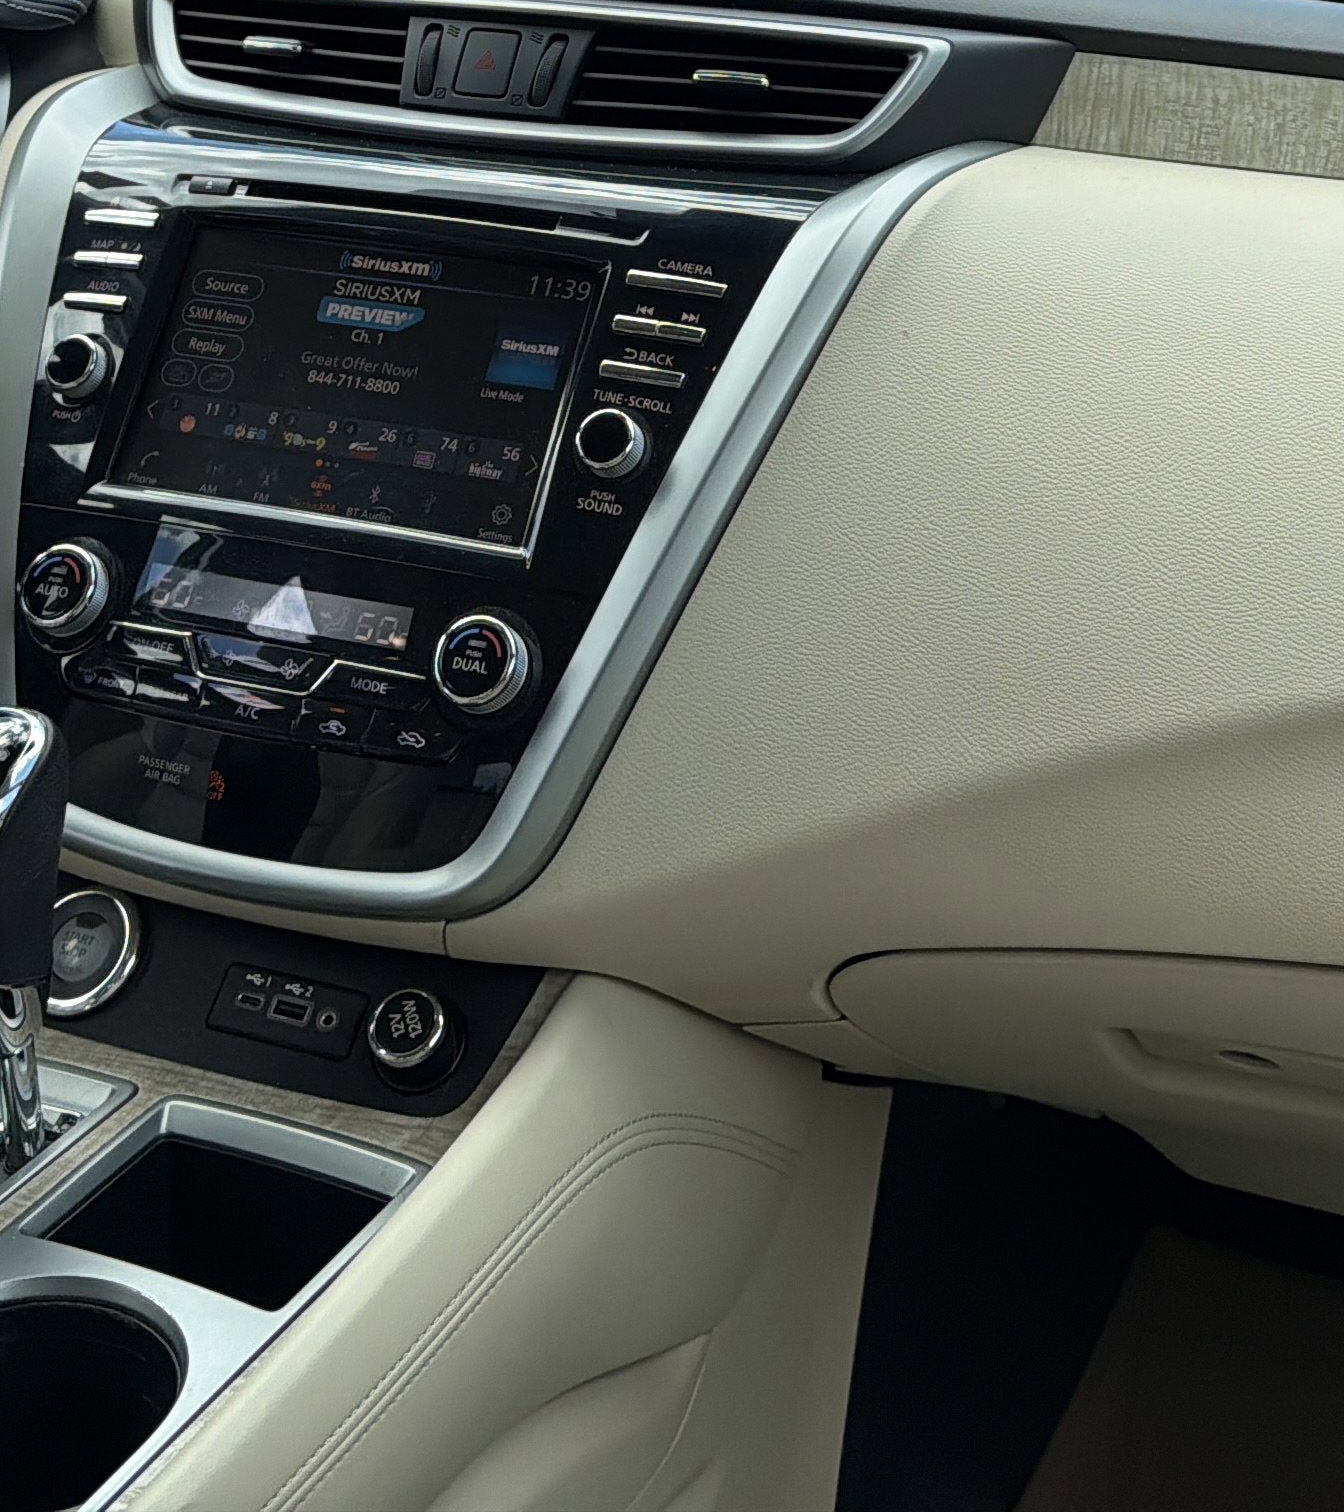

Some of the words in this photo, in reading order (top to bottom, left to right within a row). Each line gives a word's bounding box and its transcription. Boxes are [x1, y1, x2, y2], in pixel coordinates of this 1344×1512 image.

[90, 239, 114, 250] MAP
[657, 258, 713, 276] CAMERA
[87, 279, 120, 292] AUDIO
[204, 276, 249, 295] Source
[333, 279, 422, 305] SIRIUSXM
[527, 275, 592, 301] 11:39
[187, 305, 214, 321] SXM
[214, 308, 248, 325] Menu
[325, 302, 414, 326] PREVIEW
[351, 328, 372, 345] Ch.
[187, 336, 226, 356] Replay
[500, 338, 560, 357] SiriusXM
[300, 350, 338, 369] Great
[342, 356, 378, 375] Offer
[381, 361, 419, 379] Now!
[638, 350, 675, 367] BACK
[307, 369, 400, 395] 844-711-8800
[480, 387, 498, 400] Live
[498, 390, 525, 403] Mode
[205, 402, 221, 416] 11
[267, 411, 279, 425] 8
[327, 419, 338, 434] 9
[378, 428, 398, 443] 26
[440, 436, 458, 452] 74
[501, 446, 521, 462] 56
[127, 472, 158, 485] Phone
[198, 483, 219, 495] AM
[253, 492, 270, 502] FM
[589, 489, 616, 502] PUSH
[345, 506, 358, 518] BT
[359, 509, 392, 523] Audio
[576, 497, 623, 516] SOUND
[477, 527, 513, 544] Settings
[34, 583, 69, 600] AUTO
[451, 655, 488, 675] DUAL
[350, 677, 388, 695] MODE
[234, 704, 260, 720] A/C
[138, 755, 192, 775] PASSENGER
[144, 768, 161, 779] AIR
[162, 772, 181, 785] BAG
[62, 930, 96, 946] START
[388, 1012, 405, 1039] 12V
[401, 999, 424, 1040] 120W
